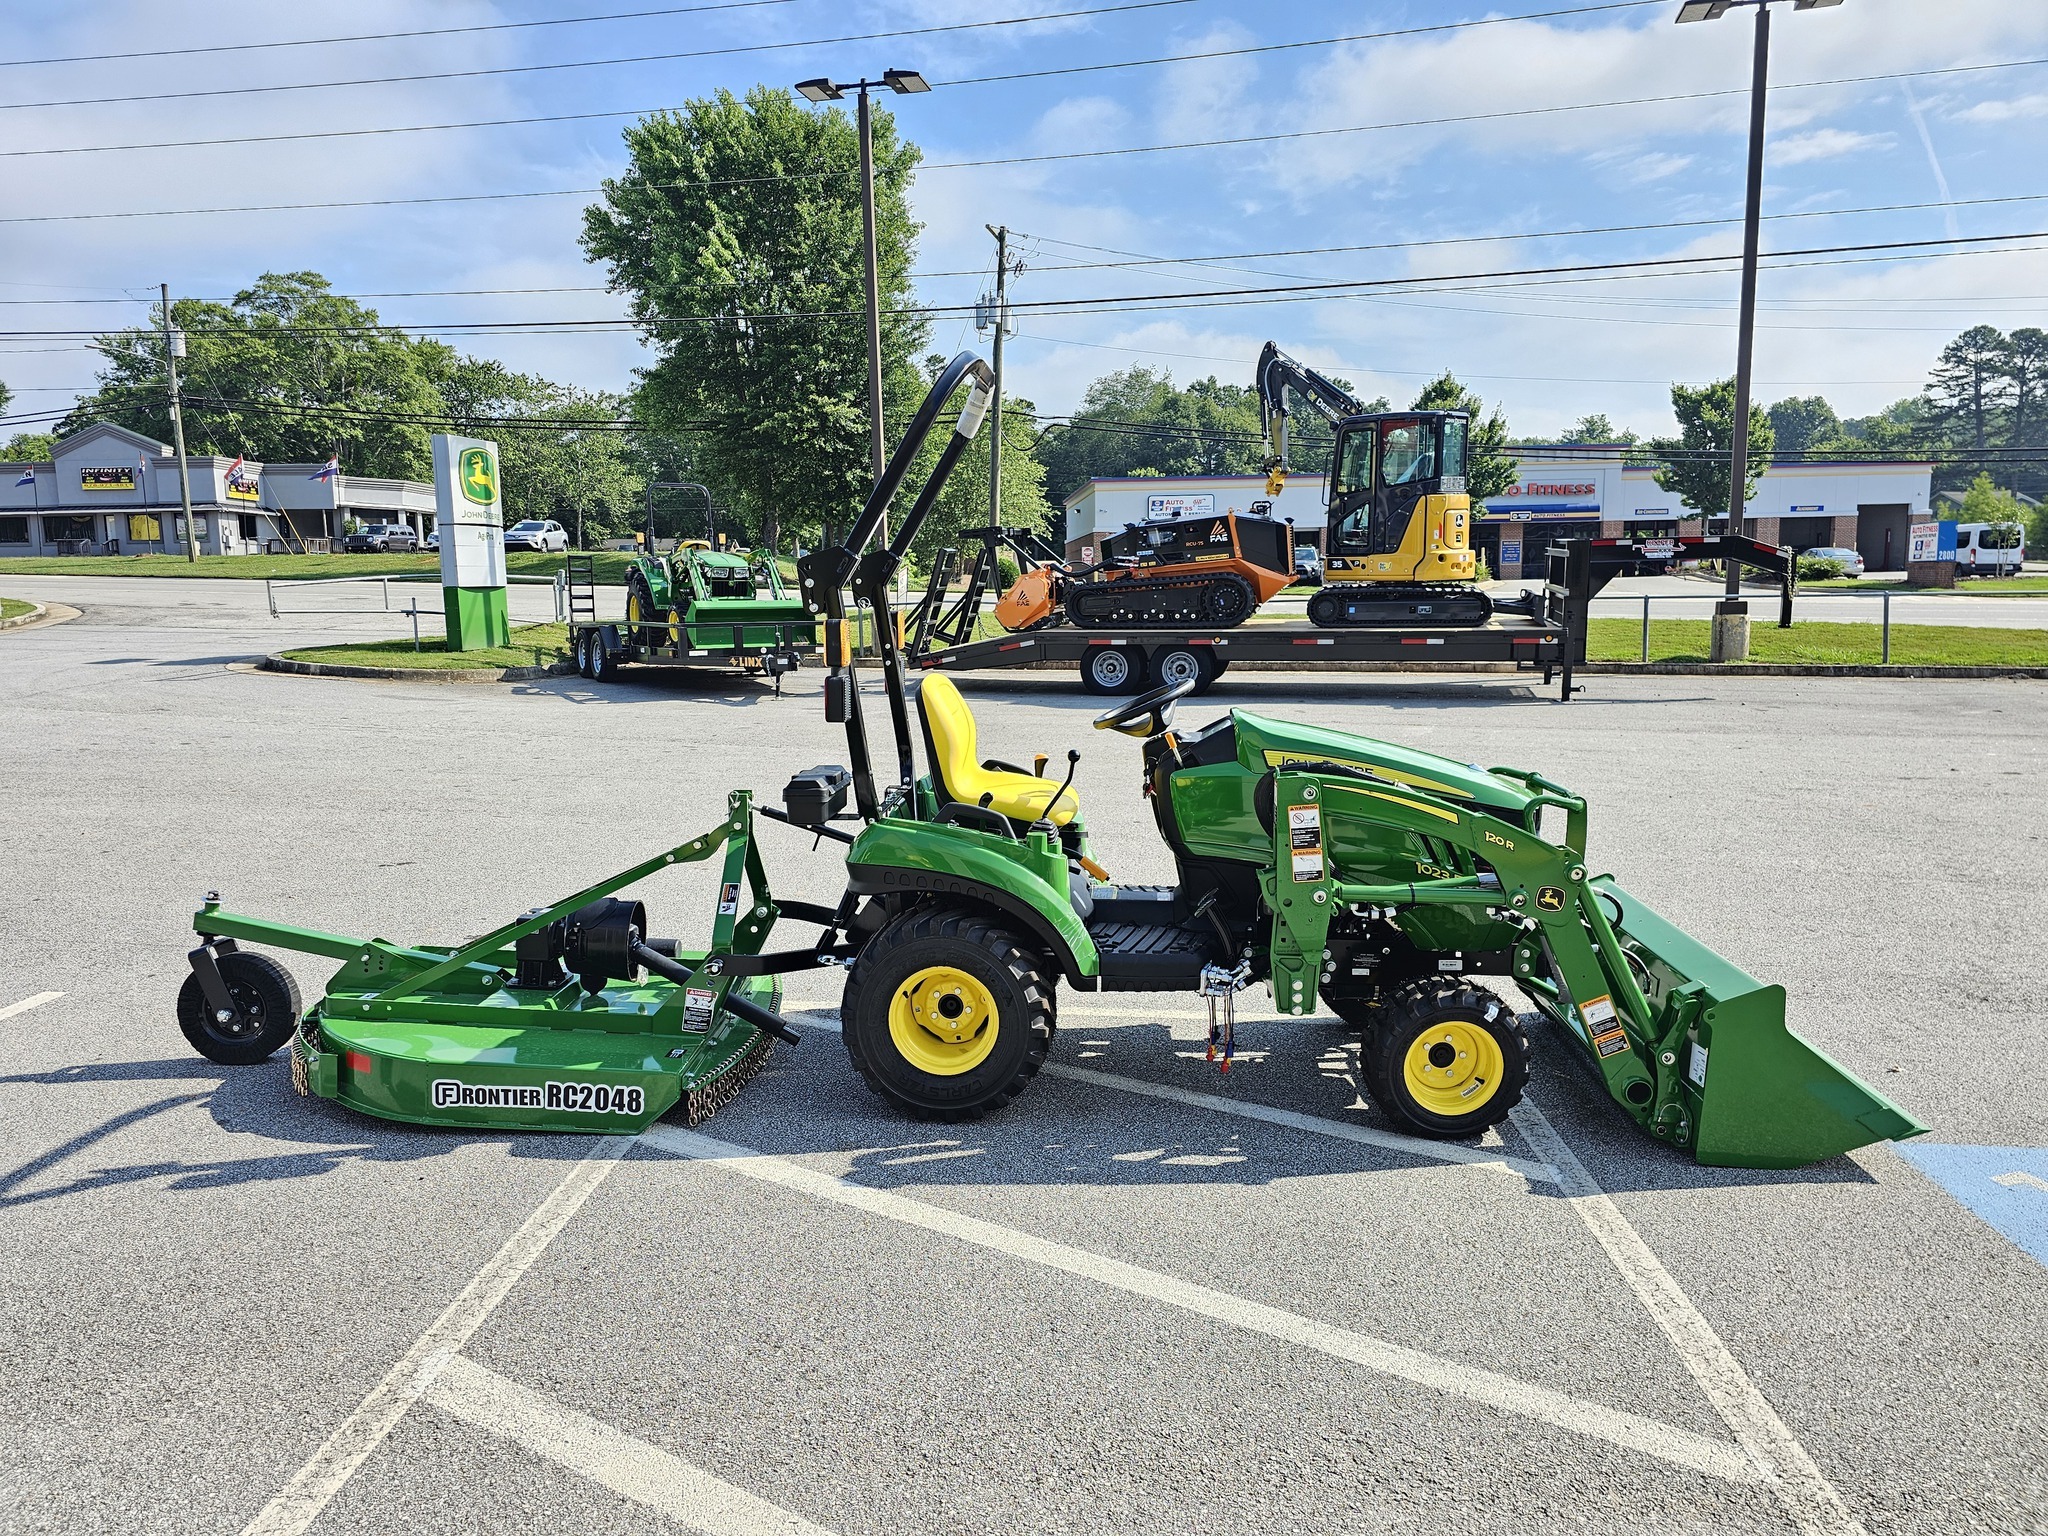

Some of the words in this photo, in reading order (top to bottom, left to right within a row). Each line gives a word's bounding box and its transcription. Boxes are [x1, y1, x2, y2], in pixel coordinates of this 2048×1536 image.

[1315, 397, 1340, 421] DEERE
[1528, 482, 1596, 497] FITNESS
[461, 510, 483, 519] JOHN
[483, 511, 500, 521] DEERE
[1912, 526, 1922, 534] AUTO
[1923, 525, 1938, 533] FITNESS
[1210, 533, 1229, 543] FAE
[1939, 550, 1955, 560] 2800
[1332, 560, 1343, 568] 35
[739, 656, 763, 668] LINX
[1588, 997, 1607, 1006] WARNING
[1602, 1032, 1622, 1041] WARNING
[435, 1082, 541, 1106] FRONTIER
[547, 1084, 642, 1112] RC2048
